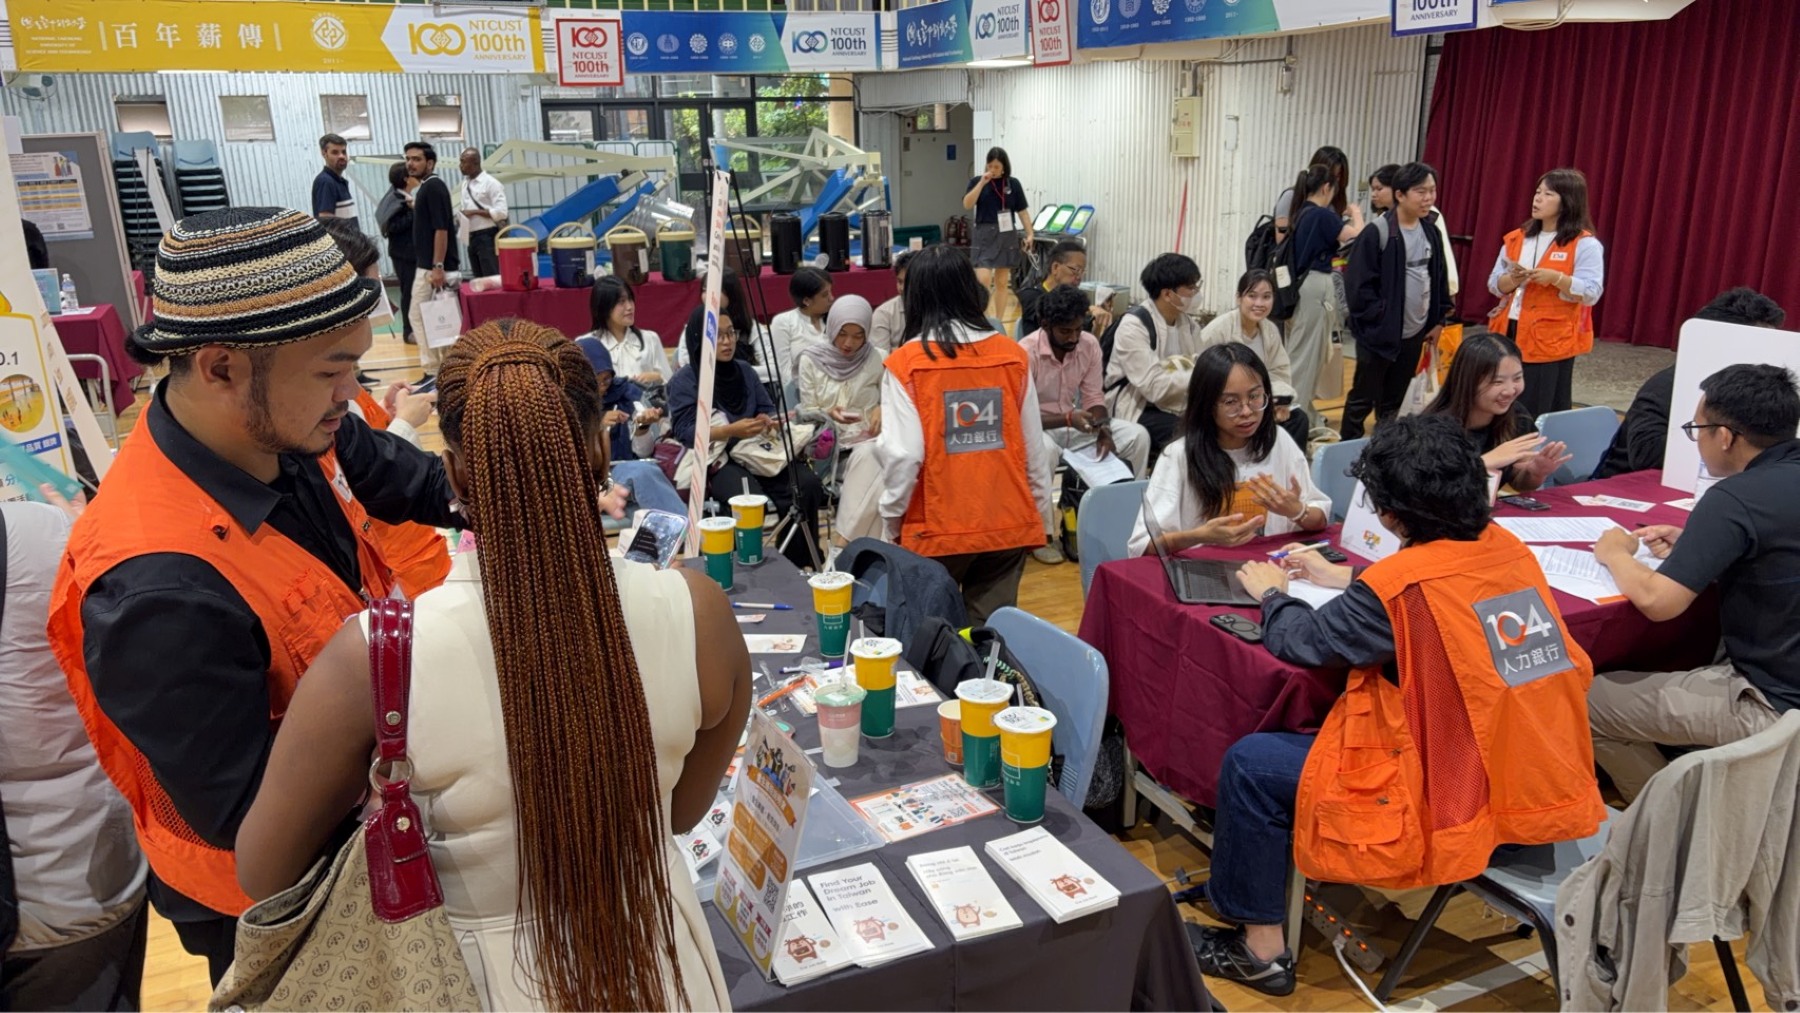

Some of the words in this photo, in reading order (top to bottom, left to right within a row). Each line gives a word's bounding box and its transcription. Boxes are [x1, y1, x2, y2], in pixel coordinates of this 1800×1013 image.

[997, 4, 1020, 16] NTCUST
[1411, 9, 1458, 21] ANNIVERSARY
[469, 20, 522, 31] NTCUST
[998, 16, 1020, 33] 100th
[1040, 26, 1061, 36] NTCUST
[111, 22, 264, 49] 百年薪傳
[830, 27, 866, 37] NTCUST
[470, 33, 526, 52] 100th
[830, 37, 867, 50] 100th
[1040, 37, 1063, 51] 100th
[474, 53, 527, 61] ANNIVERSARY
[573, 51, 608, 60] NTCUST
[573, 60, 609, 73] 100th
[949, 400, 998, 428] 104
[949, 430, 998, 445] 人力銀行
[1486, 603, 1553, 650] 104
[1503, 643, 1560, 675] 人力銀行
[820, 880, 840, 888] Find
[842, 876, 863, 884] Your
[824, 885, 857, 895] Dream
[859, 880, 876, 888] Job
[838, 888, 872, 899] Taiwan
[833, 904, 854, 912] with
[855, 900, 878, 908] Ease
